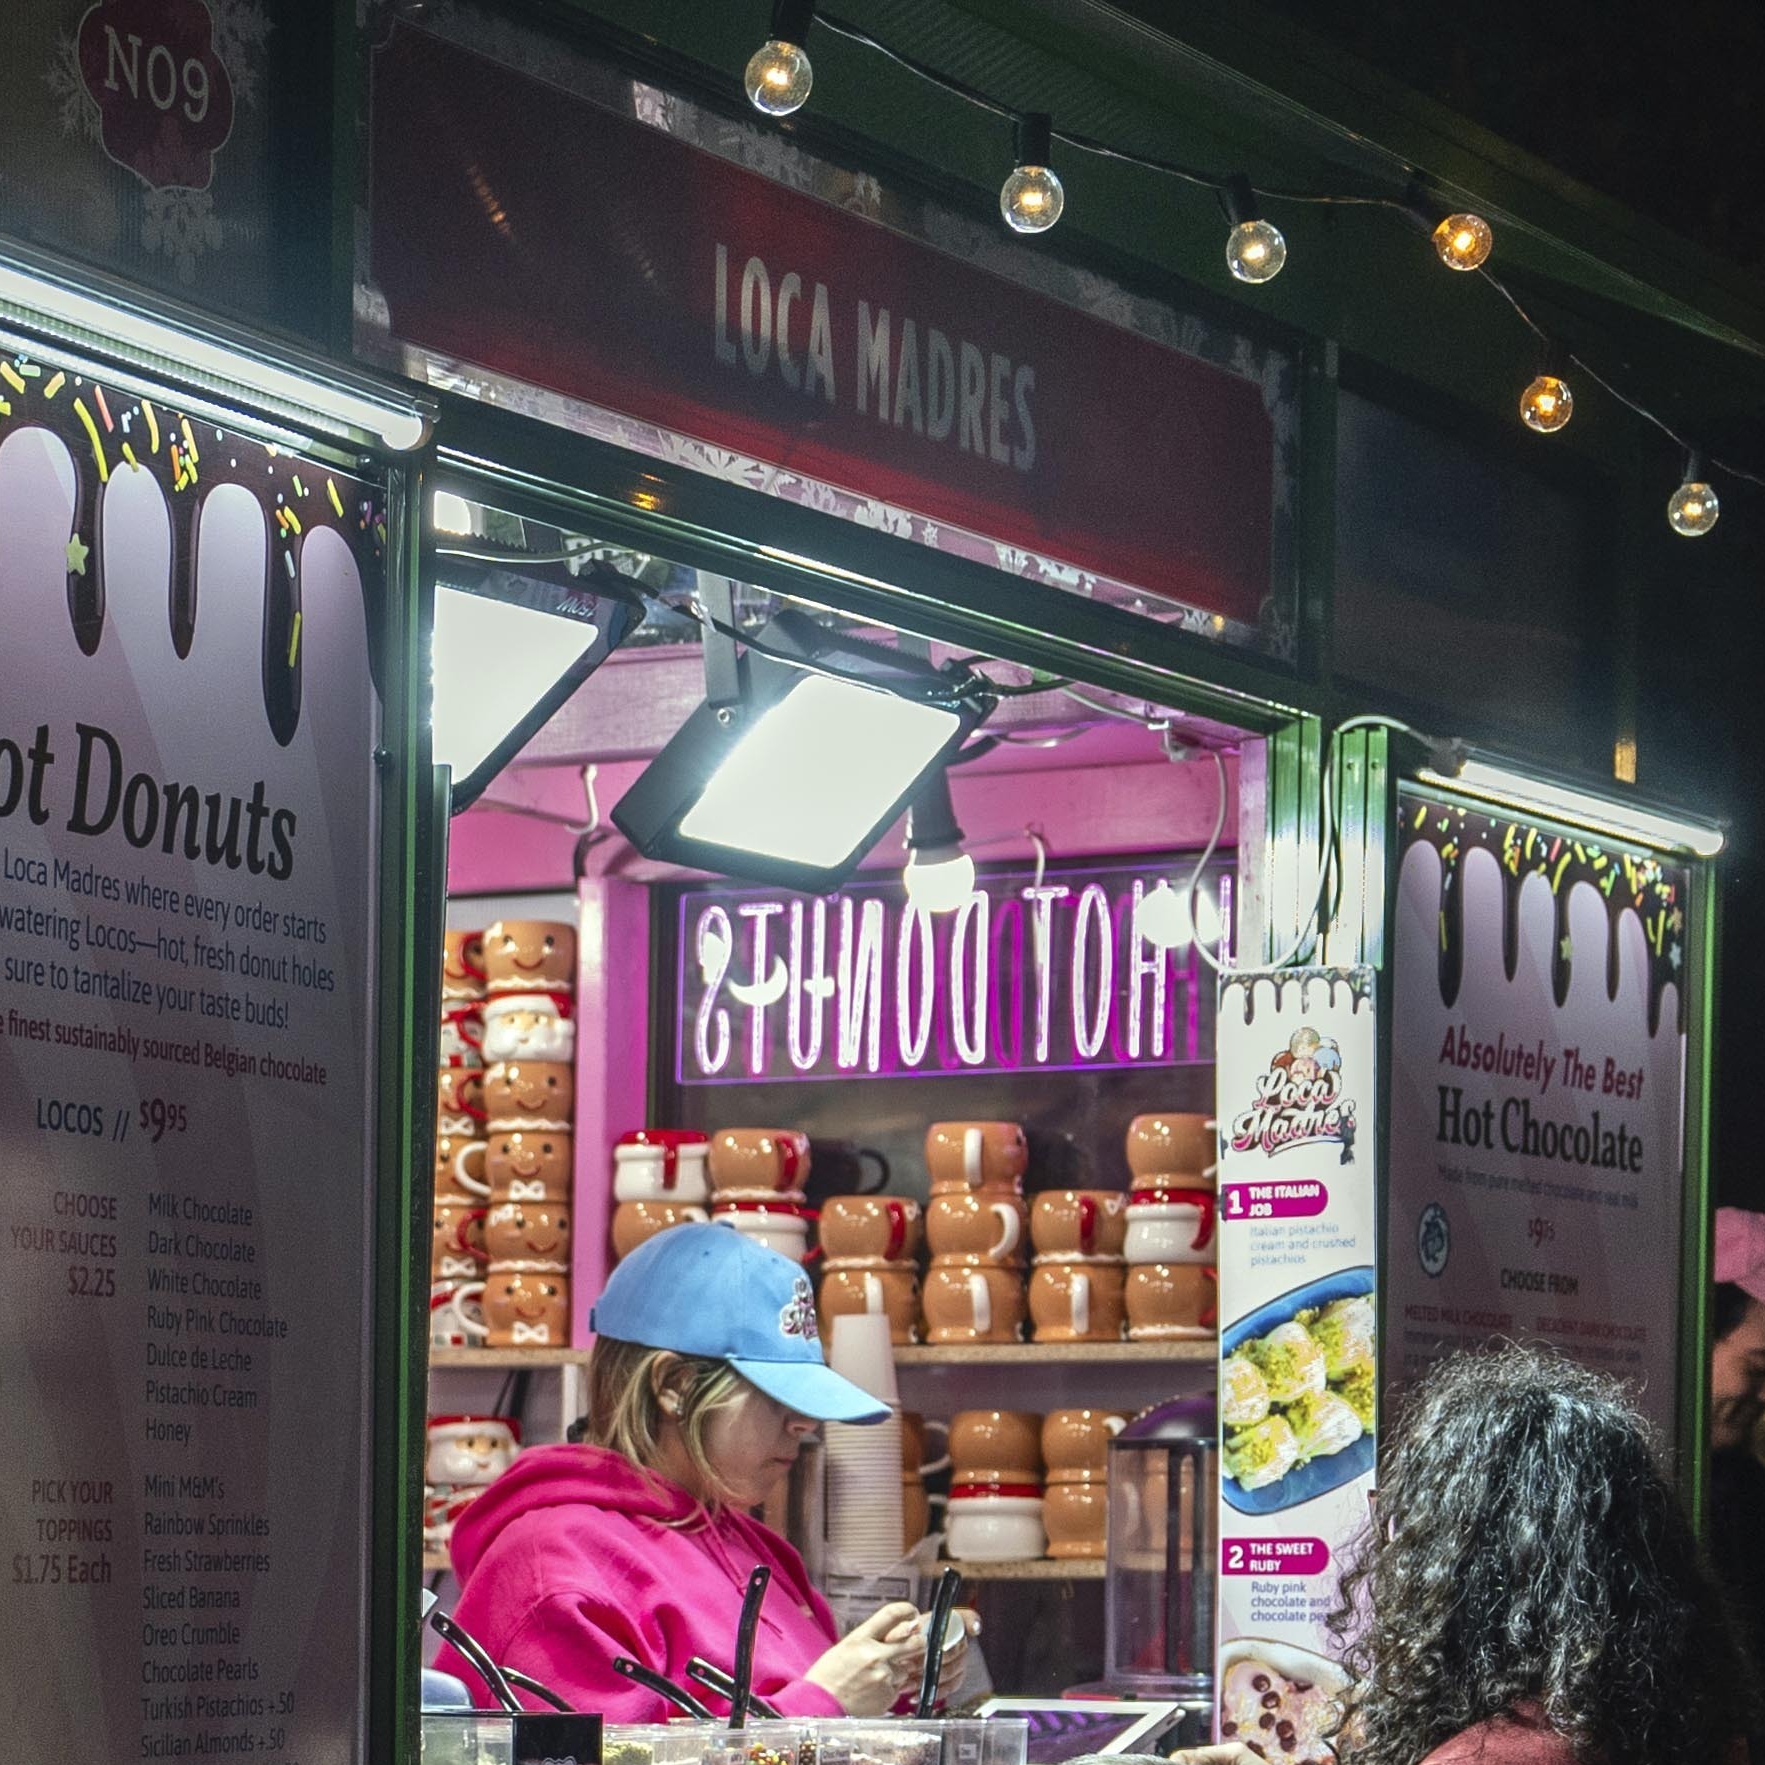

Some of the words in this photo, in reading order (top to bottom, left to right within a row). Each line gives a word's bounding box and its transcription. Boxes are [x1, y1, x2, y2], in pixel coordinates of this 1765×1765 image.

[715, 243, 837, 403] LOCA
[855, 299, 1038, 473] MADRES
[67, 722, 297, 882] Donuts
[4, 847, 48, 888] Loca
[54, 857, 121, 902] Madres
[125, 874, 180, 915] where
[184, 893, 231, 933] every
[234, 902, 280, 936] order
[282, 912, 327, 945] starts
[194, 935, 235, 974] fresh
[239, 945, 289, 984] donut
[292, 955, 336, 993] holes
[5, 956, 45, 987] sure
[50, 960, 69, 991] to
[74, 965, 154, 1007] tantalize
[155, 982, 196, 1016] your
[198, 988, 241, 1021] taste
[245, 993, 290, 1031] buds!
[8, 1008, 53, 1042] finest
[55, 1022, 141, 1064] sustainably
[142, 1038, 201, 1067] sourced
[204, 1043, 257, 1079] Belgian
[260, 1052, 329, 1086] chocolate
[1439, 1024, 1556, 1095] Absolutely
[1562, 1046, 1596, 1091] The
[1602, 1056, 1644, 1100] Best
[1253, 1066, 1343, 1111] Loca
[36, 1098, 104, 1138] LOCOS
[1436, 1084, 1495, 1150] Hot
[1500, 1097, 1644, 1174] Chocolate
[54, 1191, 119, 1221] CHOOSE
[149, 1193, 180, 1220] Milk
[183, 1197, 254, 1227] Chocolate
[1229, 1190, 1244, 1215] 1
[1248, 1186, 1274, 1202] THE
[1275, 1184, 1321, 1200] ITALIAN
[1248, 1203, 1273, 1217] JOB
[11, 1226, 56, 1253] YOUR
[58, 1231, 118, 1259] SAUCES
[149, 1231, 182, 1257] Dark
[185, 1235, 256, 1264] Chocolate
[67, 1266, 117, 1298] $2.25
[148, 1268, 189, 1295] White
[192, 1272, 263, 1301] Chocolate
[1500, 1267, 1547, 1294] CHOOSE
[1548, 1272, 1579, 1297] FROM
[148, 1305, 183, 1337] Ruby
[186, 1309, 217, 1335] Pink
[220, 1312, 289, 1340] Chocolate
[147, 1343, 187, 1367] Dulce
[191, 1345, 208, 1369] de
[212, 1348, 253, 1373] Leche
[146, 1380, 210, 1407] Pistachio
[213, 1384, 258, 1409] Cream
[146, 1418, 192, 1448] Honey
[32, 1479, 67, 1504] PICK
[72, 1480, 114, 1505] YOUR
[36, 1518, 114, 1543] TOPPINGS
[12, 1554, 63, 1586] $1.75
[67, 1554, 113, 1586] Each
[1228, 1544, 1244, 1569] 2
[1248, 1542, 1274, 1556] THE
[1275, 1542, 1315, 1556] SWEET
[1249, 1559, 1282, 1573] RUBY
[1250, 1595, 1307, 1608] chocolate
[1309, 1595, 1331, 1608] and
[1251, 1581, 1279, 1596] Ruby
[1282, 1581, 1307, 1595] pink
[1250, 1609, 1307, 1622] chocolate
